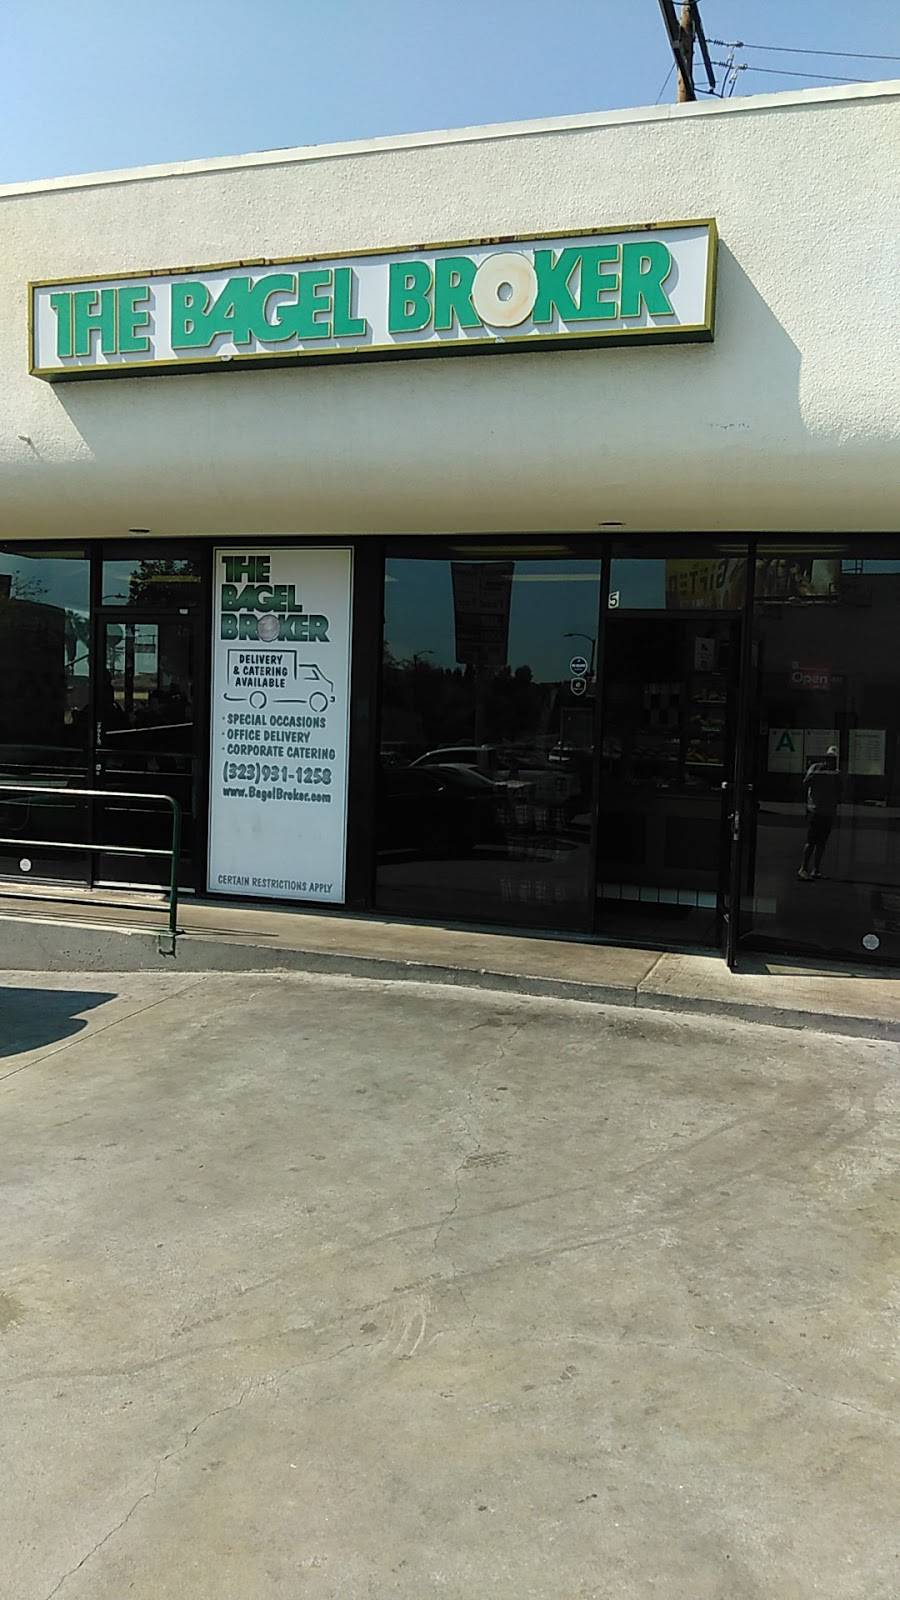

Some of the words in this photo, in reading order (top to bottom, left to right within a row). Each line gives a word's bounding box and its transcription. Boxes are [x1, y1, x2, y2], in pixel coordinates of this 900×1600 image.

[50, 286, 151, 357] THE
[171, 267, 366, 349] BAGEL
[389, 241, 674, 333] BROKER
[222, 556, 271, 583] THE
[221, 584, 302, 612] BAGEL
[609, 593, 617, 607] 5
[221, 613, 330, 642] BROKER
[239, 654, 283, 665] DELIVERY
[233, 666, 240, 675] &
[243, 665, 288, 677] CATERING
[791, 672, 829, 685] Open
[235, 677, 286, 688] AVAILABLE
[227, 713, 267, 726] SPECIAL
[269, 715, 326, 728] OCCASIONS
[227, 729, 260, 741] OFFICE
[263, 730, 310, 743] DELIVERY
[776, 731, 796, 752] A
[227, 743, 284, 757] CORPORATE
[287, 747, 336, 760] CATERING
[223, 761, 332, 785] (323)931-1258
[222, 786, 331, 802] www.BagelBroker.com
[218, 874, 250, 885] CERTAIN
[252, 877, 307, 891] RESTRICTIONS
[309, 882, 333, 893] APPLY
